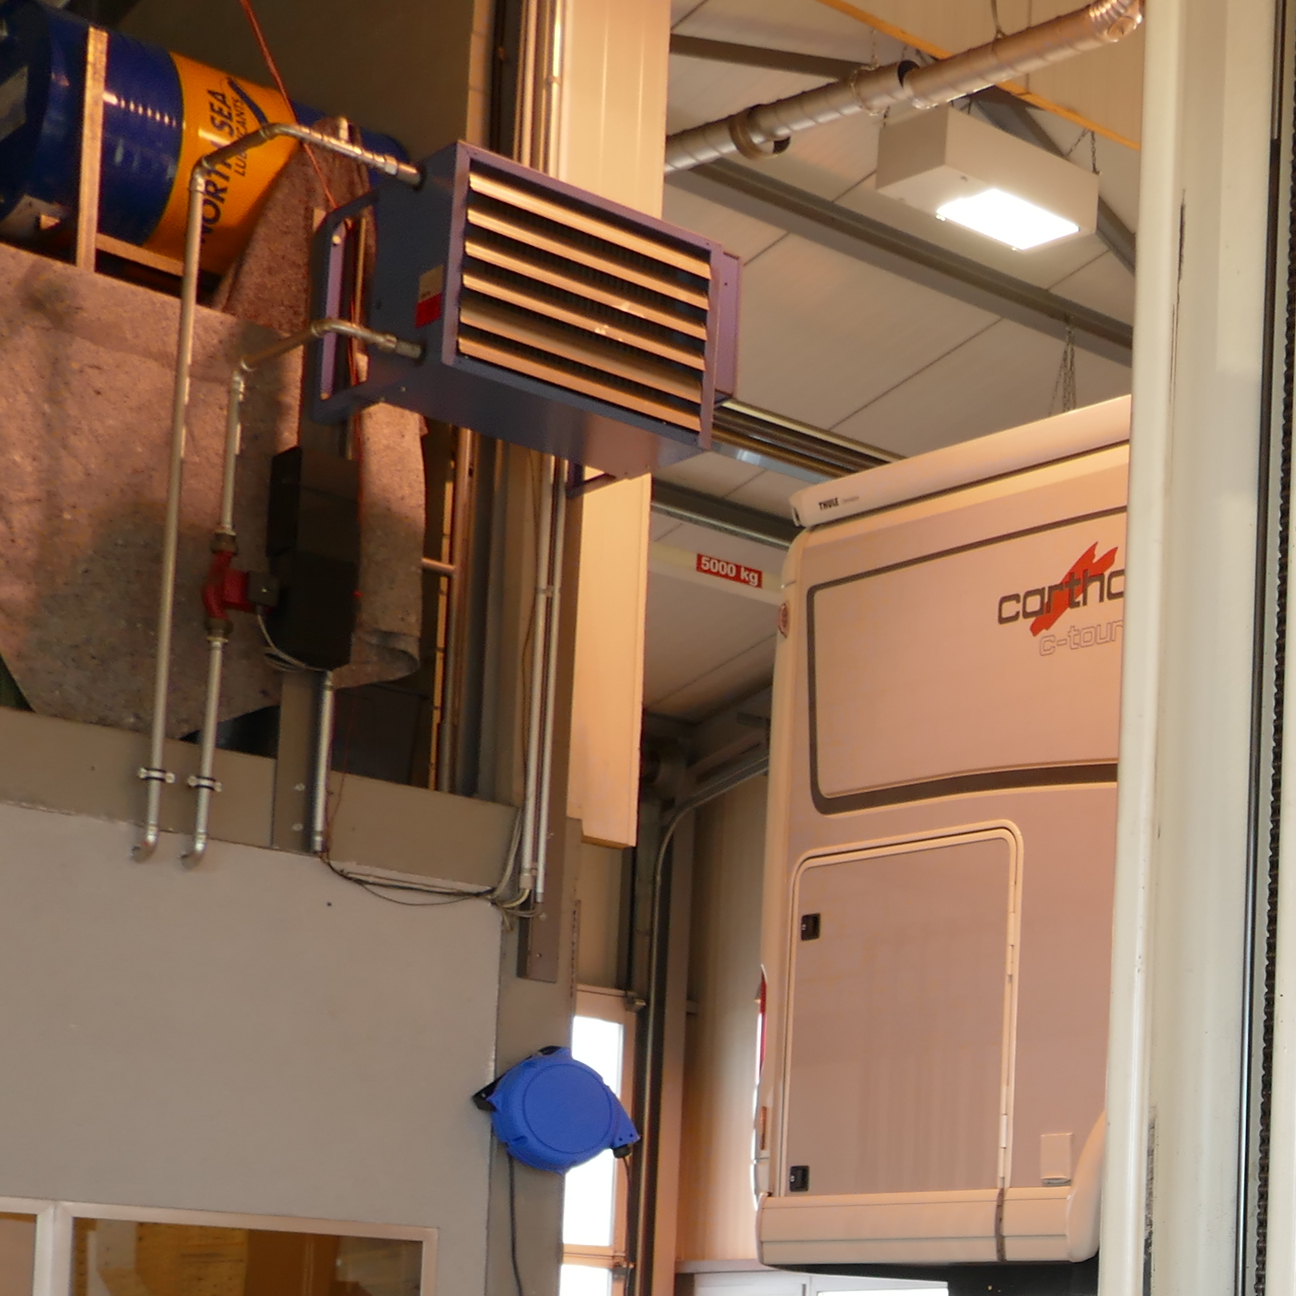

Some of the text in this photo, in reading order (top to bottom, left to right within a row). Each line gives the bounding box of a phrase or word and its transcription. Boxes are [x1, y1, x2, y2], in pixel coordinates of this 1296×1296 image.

[207, 89, 235, 137] SEA
[232, 97, 248, 176] LUCANTS
[701, 556, 759, 587] 5000 kg
